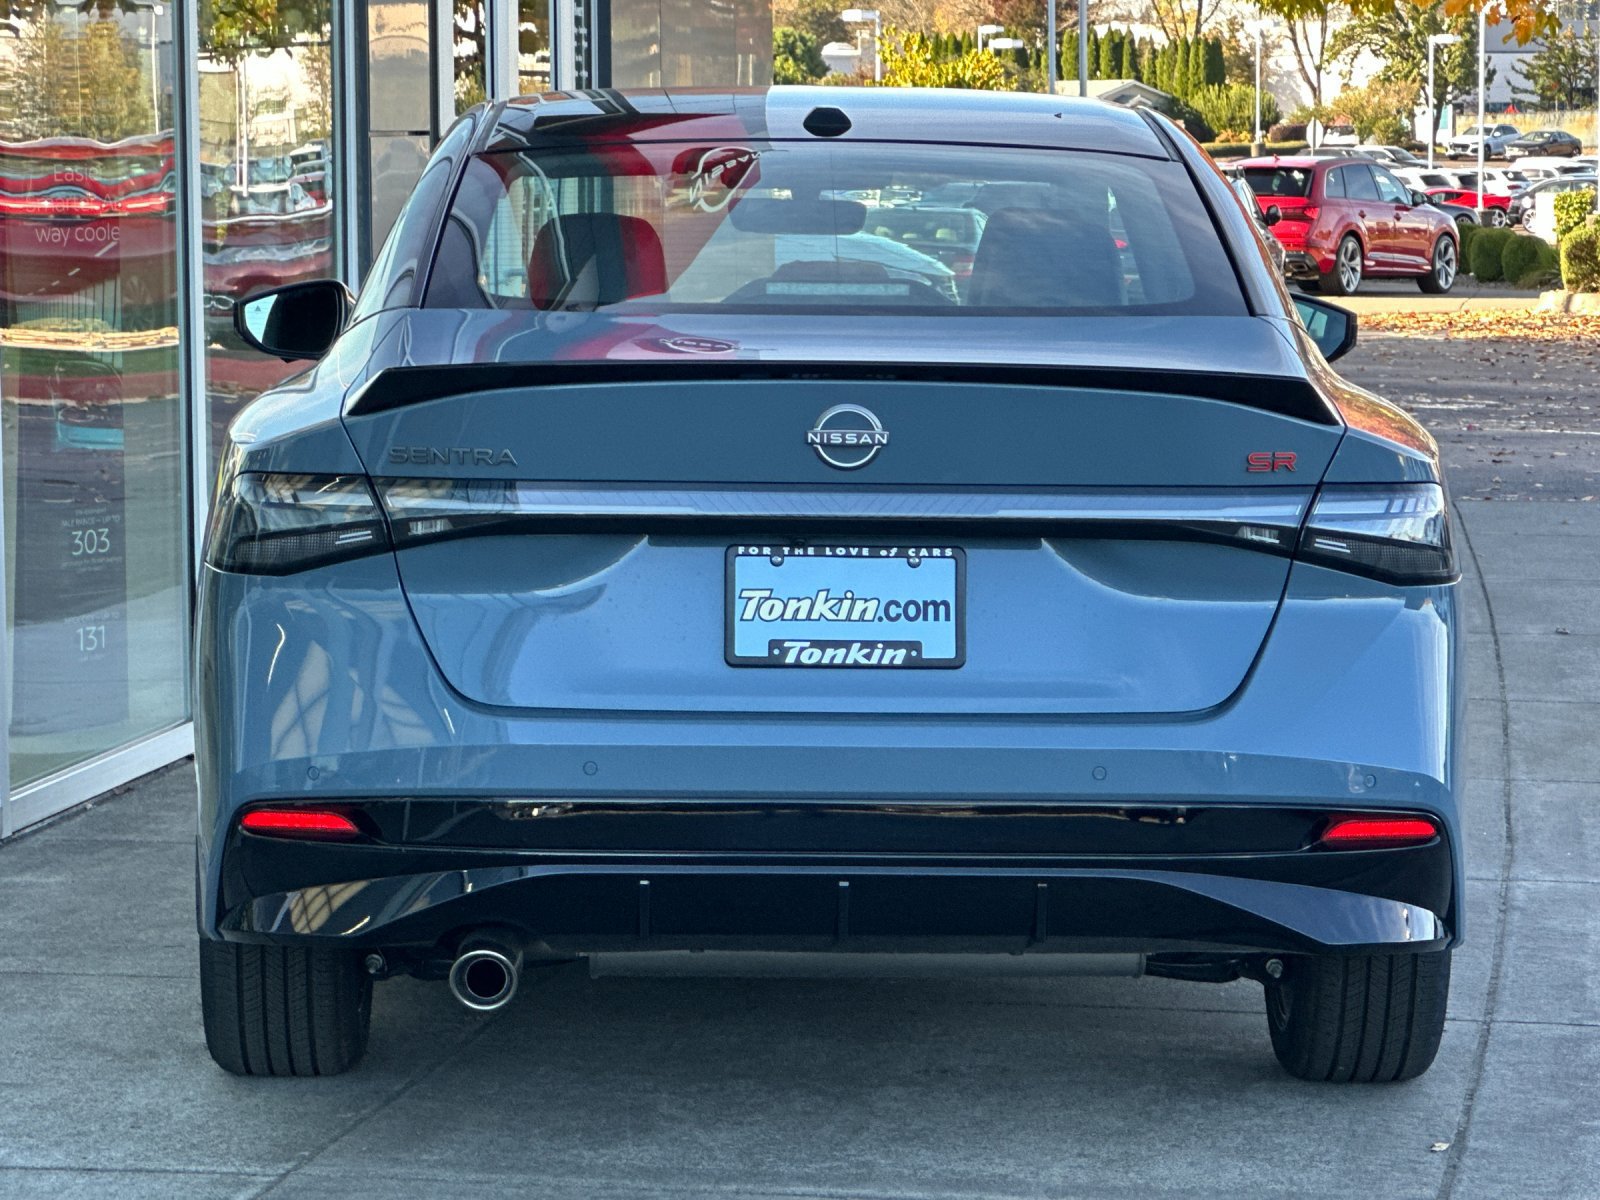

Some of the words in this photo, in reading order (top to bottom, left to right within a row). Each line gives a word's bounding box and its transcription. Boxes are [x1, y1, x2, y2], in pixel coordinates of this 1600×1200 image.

[35, 227, 71, 247] way
[74, 223, 120, 243] coole
[807, 431, 889, 445] NISSAN
[389, 447, 519, 466] SENTRA
[1247, 451, 1298, 472] SR
[71, 527, 111, 556] 303
[738, 546, 771, 555] FOR
[783, 546, 815, 556] THE
[825, 546, 869, 556] LOVE
[880, 547, 898, 557] of
[908, 547, 953, 557] CARS
[739, 588, 952, 622] Tonkin.com
[75, 624, 106, 652] 131
[783, 640, 907, 665] Tonkin
